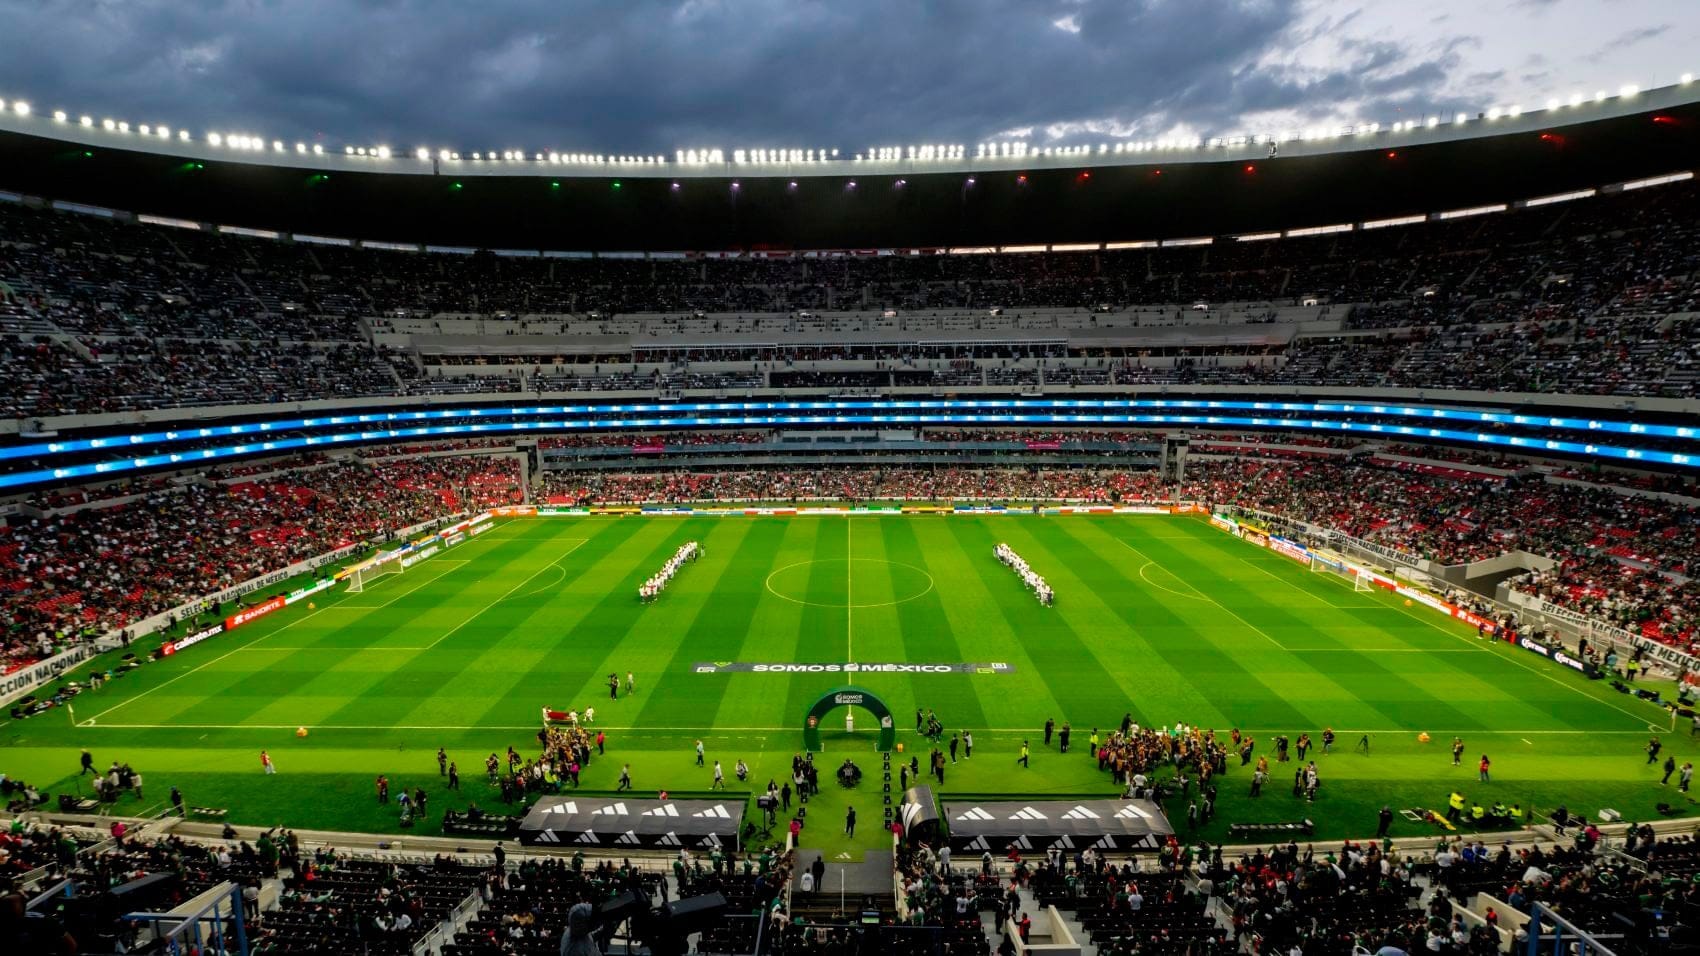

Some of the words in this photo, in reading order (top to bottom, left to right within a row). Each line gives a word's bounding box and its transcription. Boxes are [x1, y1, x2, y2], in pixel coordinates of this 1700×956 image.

[1386, 549, 1395, 558] DE
[220, 584, 255, 602] NACIONAL
[256, 580, 264, 588] DE
[244, 600, 281, 620] BANORTE
[173, 625, 223, 651] caliente.mx
[1643, 641, 1657, 654] DE
[752, 664, 841, 672] SOMOS
